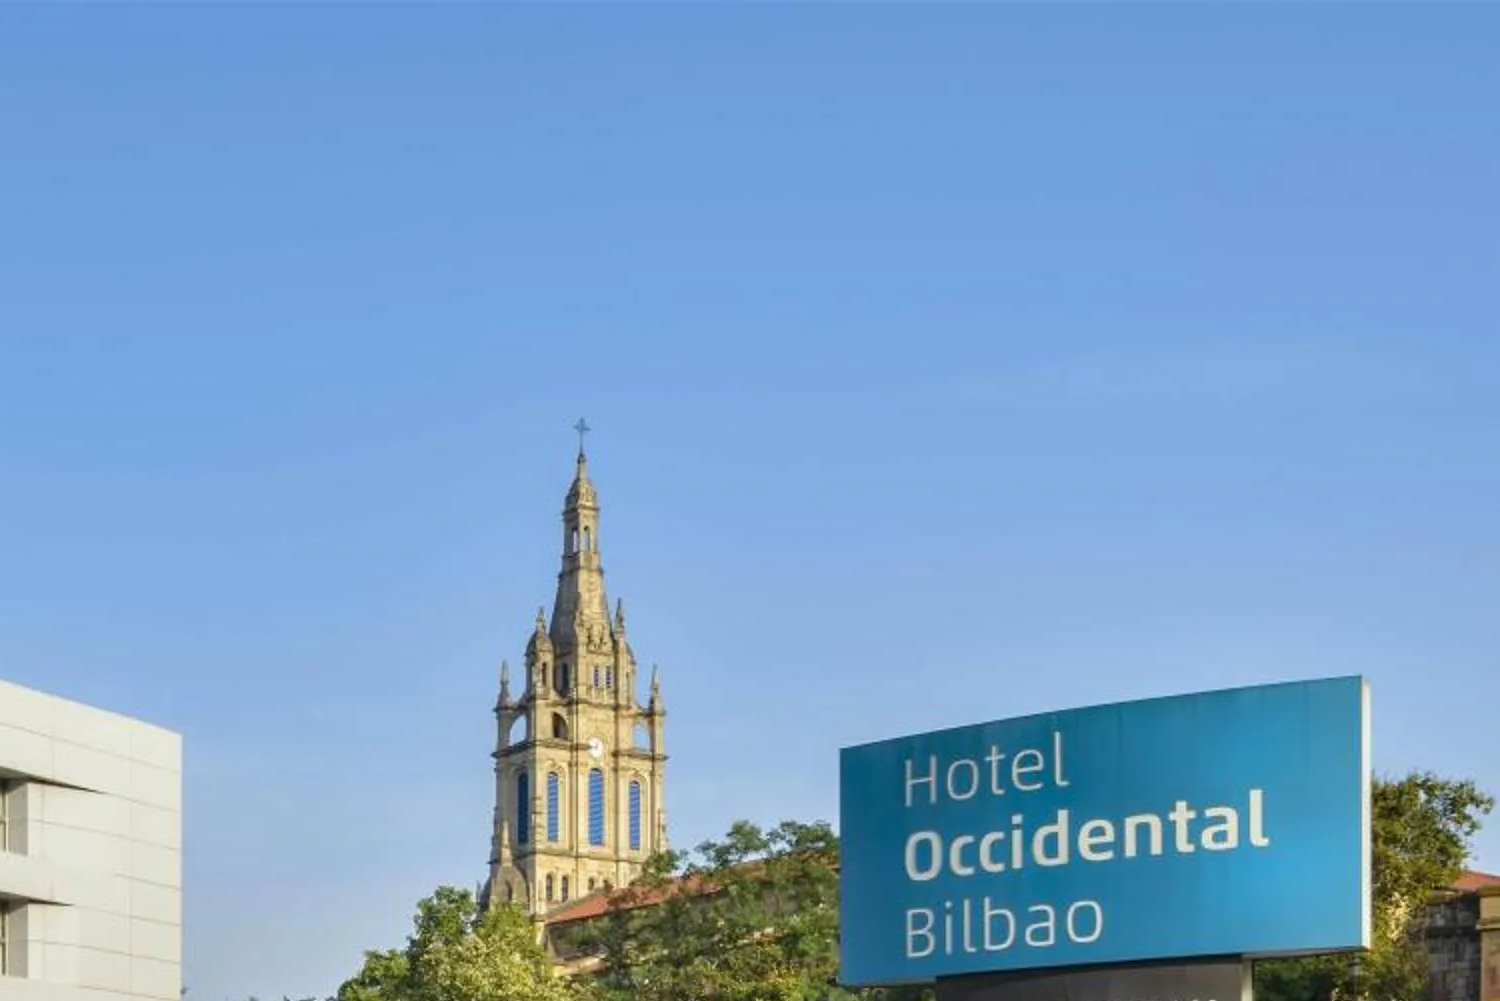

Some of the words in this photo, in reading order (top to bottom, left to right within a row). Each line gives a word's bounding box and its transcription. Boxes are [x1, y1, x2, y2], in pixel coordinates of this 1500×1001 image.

[904, 731, 1070, 807] Hotel
[904, 788, 1270, 882] Occidental
[905, 896, 1104, 959] Bilbao
